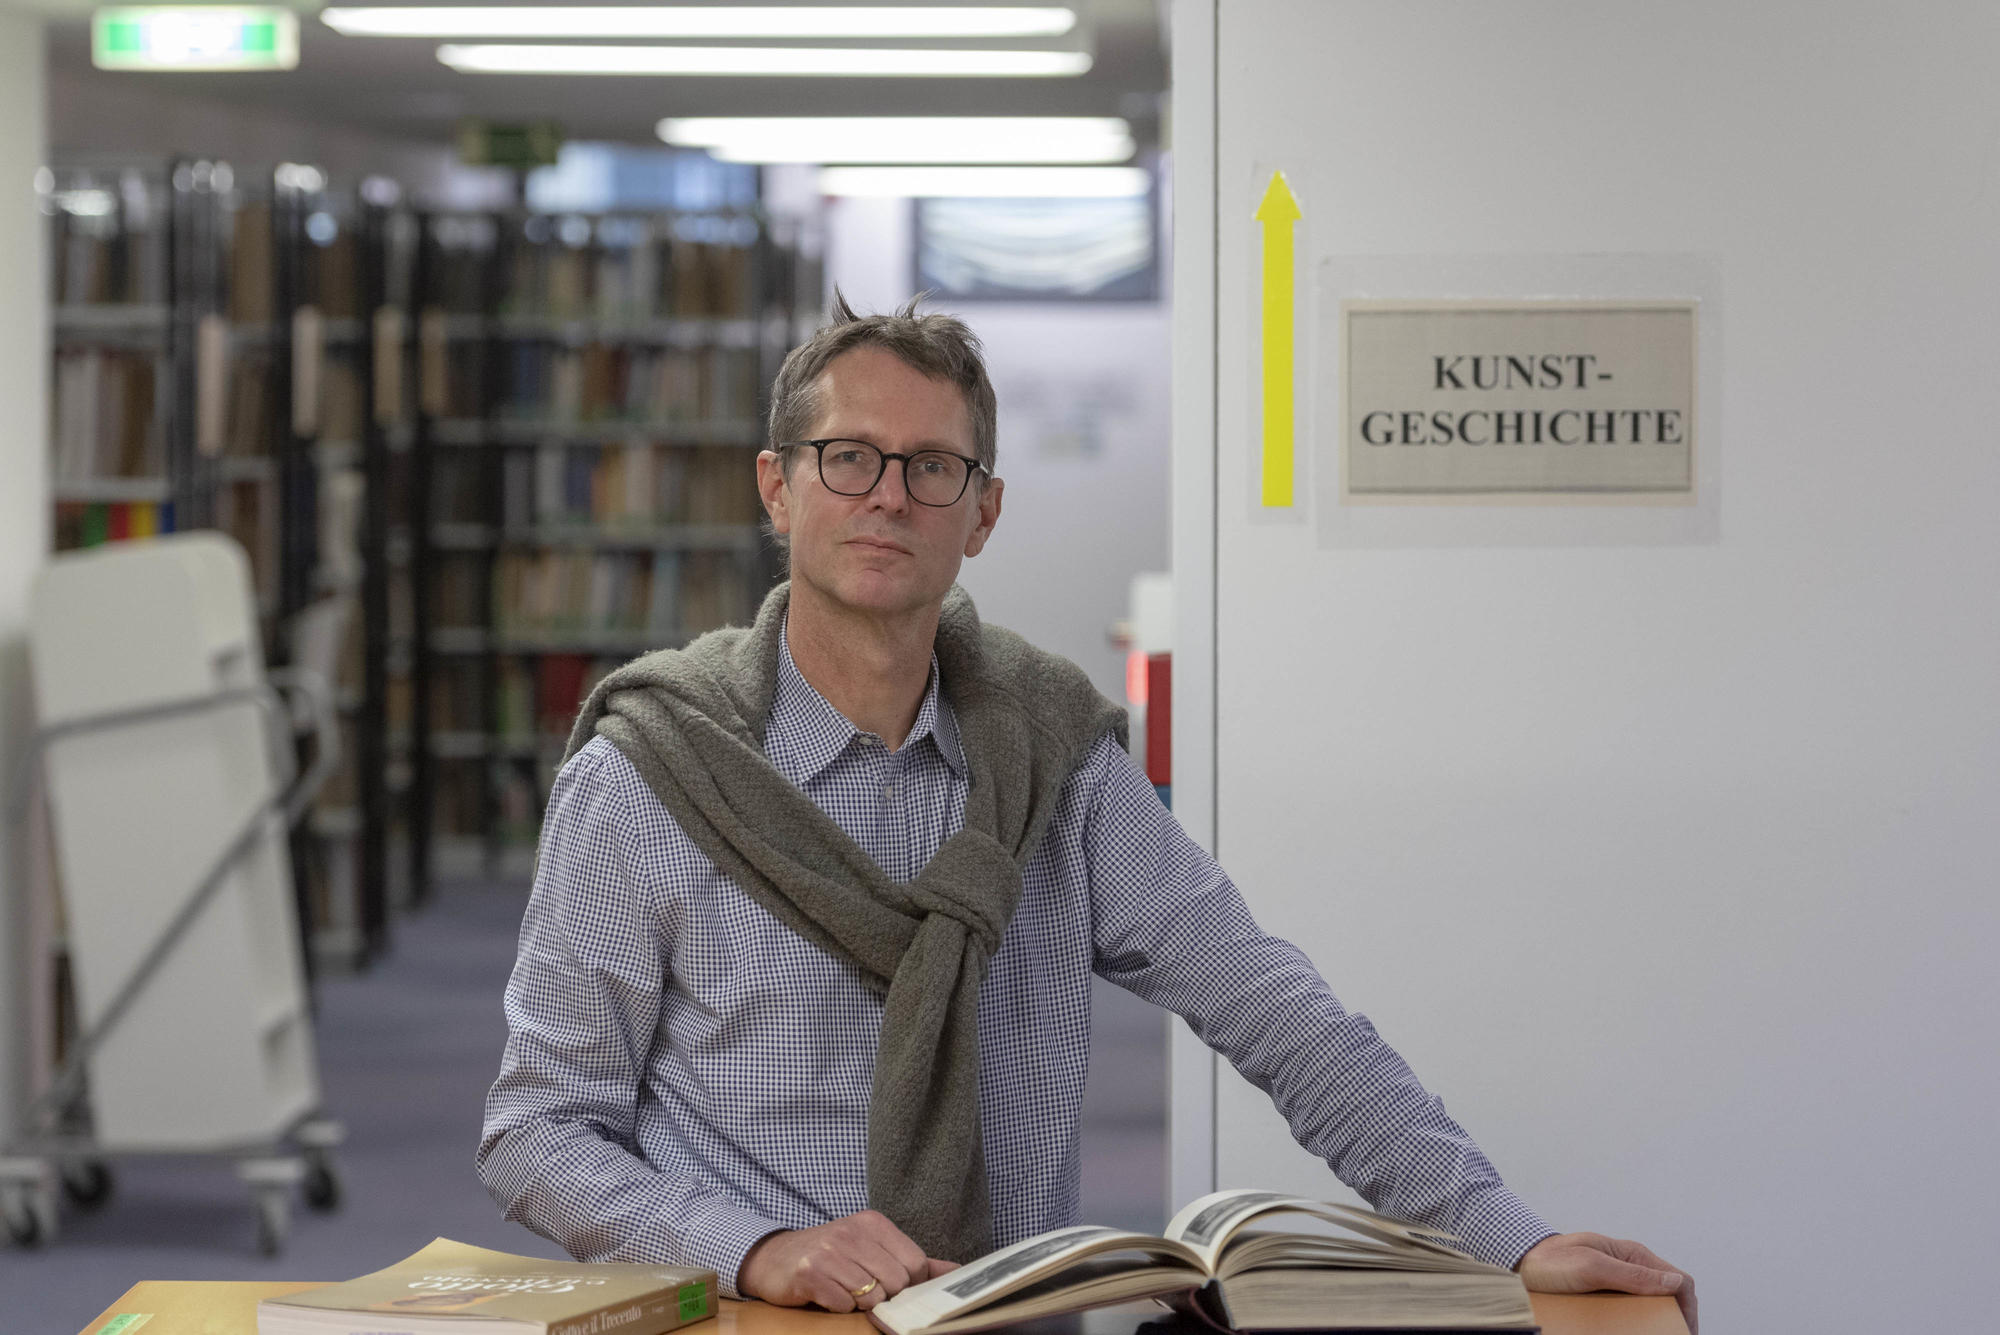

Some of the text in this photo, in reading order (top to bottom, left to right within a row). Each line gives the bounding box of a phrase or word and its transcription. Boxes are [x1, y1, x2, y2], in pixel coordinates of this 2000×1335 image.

[1433, 354, 1613, 391] KUNST-
[1361, 409, 1683, 446] GESCHICHTE
[600, 1304, 642, 1330] Trecento
